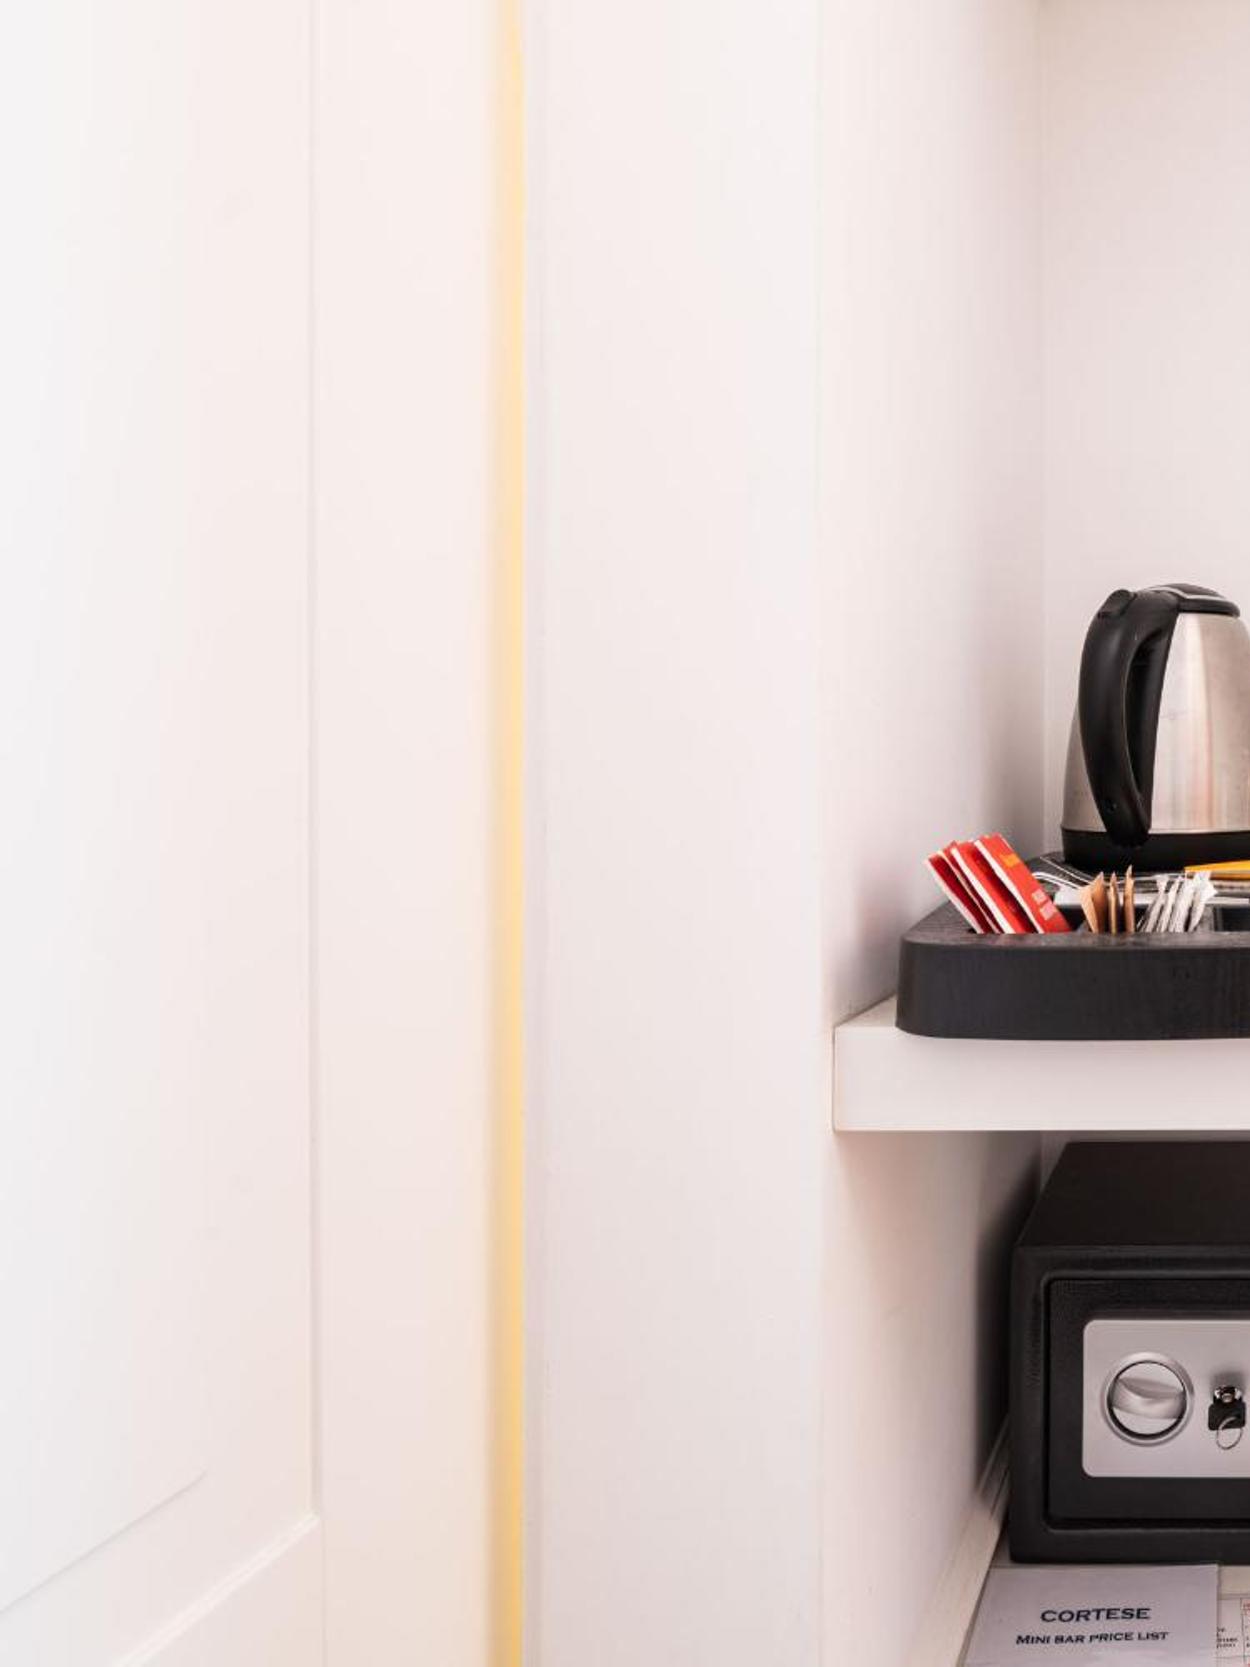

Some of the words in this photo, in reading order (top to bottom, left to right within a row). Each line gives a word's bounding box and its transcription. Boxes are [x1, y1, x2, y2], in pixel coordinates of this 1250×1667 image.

[1040, 1607, 1151, 1623] CORTESE
[1016, 1634, 1050, 1645] MINI
[1054, 1634, 1085, 1645] BAR
[1089, 1631, 1133, 1643] PRICE
[1137, 1631, 1169, 1641] LIST
